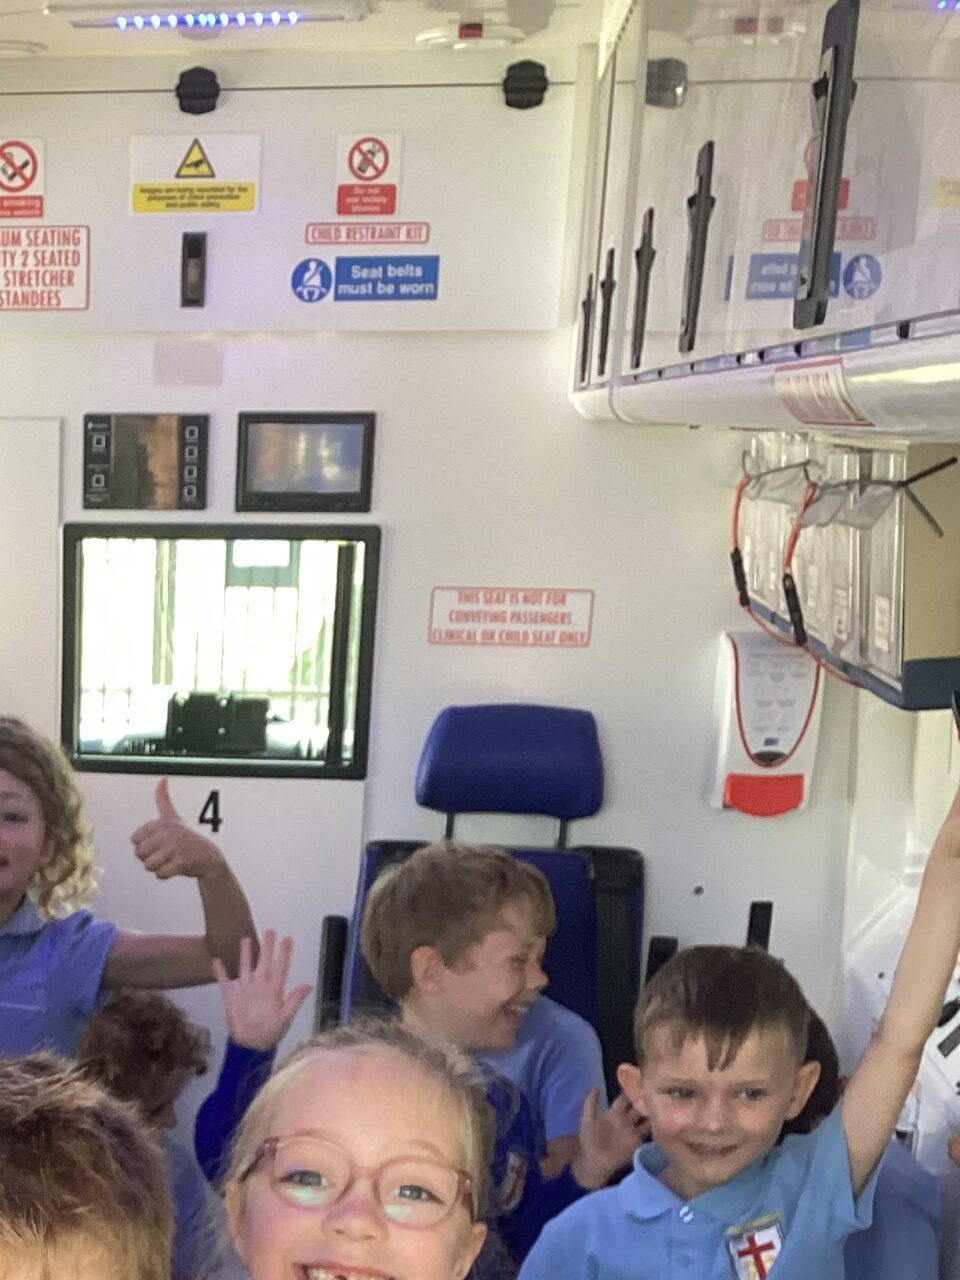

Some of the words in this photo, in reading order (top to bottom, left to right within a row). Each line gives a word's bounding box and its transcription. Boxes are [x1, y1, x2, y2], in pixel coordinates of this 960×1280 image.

[25, 229, 81, 247] SEATING
[311, 226, 341, 241] CHILD
[346, 226, 402, 241] RESTRAINT
[406, 225, 423, 241] KIT
[21, 250, 30, 267] 2
[33, 249, 81, 267] SEATED
[3, 269, 75, 288] STRETCHER
[351, 264, 383, 279] Seat
[387, 263, 423, 277] belts
[338, 281, 373, 295] must
[377, 281, 396, 294] be
[399, 283, 435, 294] worn
[458, 590, 480, 605] THIS
[483, 590, 506, 605] SEAT
[509, 590, 519, 605] IS
[522, 591, 543, 605] NOT
[545, 591, 567, 606] FOR
[448, 609, 507, 623] CONVEYING
[510, 610, 572, 625] PASSENGERS
[433, 628, 477, 643] CLINICAL
[481, 629, 495, 643] OR
[499, 630, 529, 643] CHILD
[532, 631, 556, 645] SEAT
[559, 632, 588, 645] ONLY
[199, 789, 223, 833] 4
